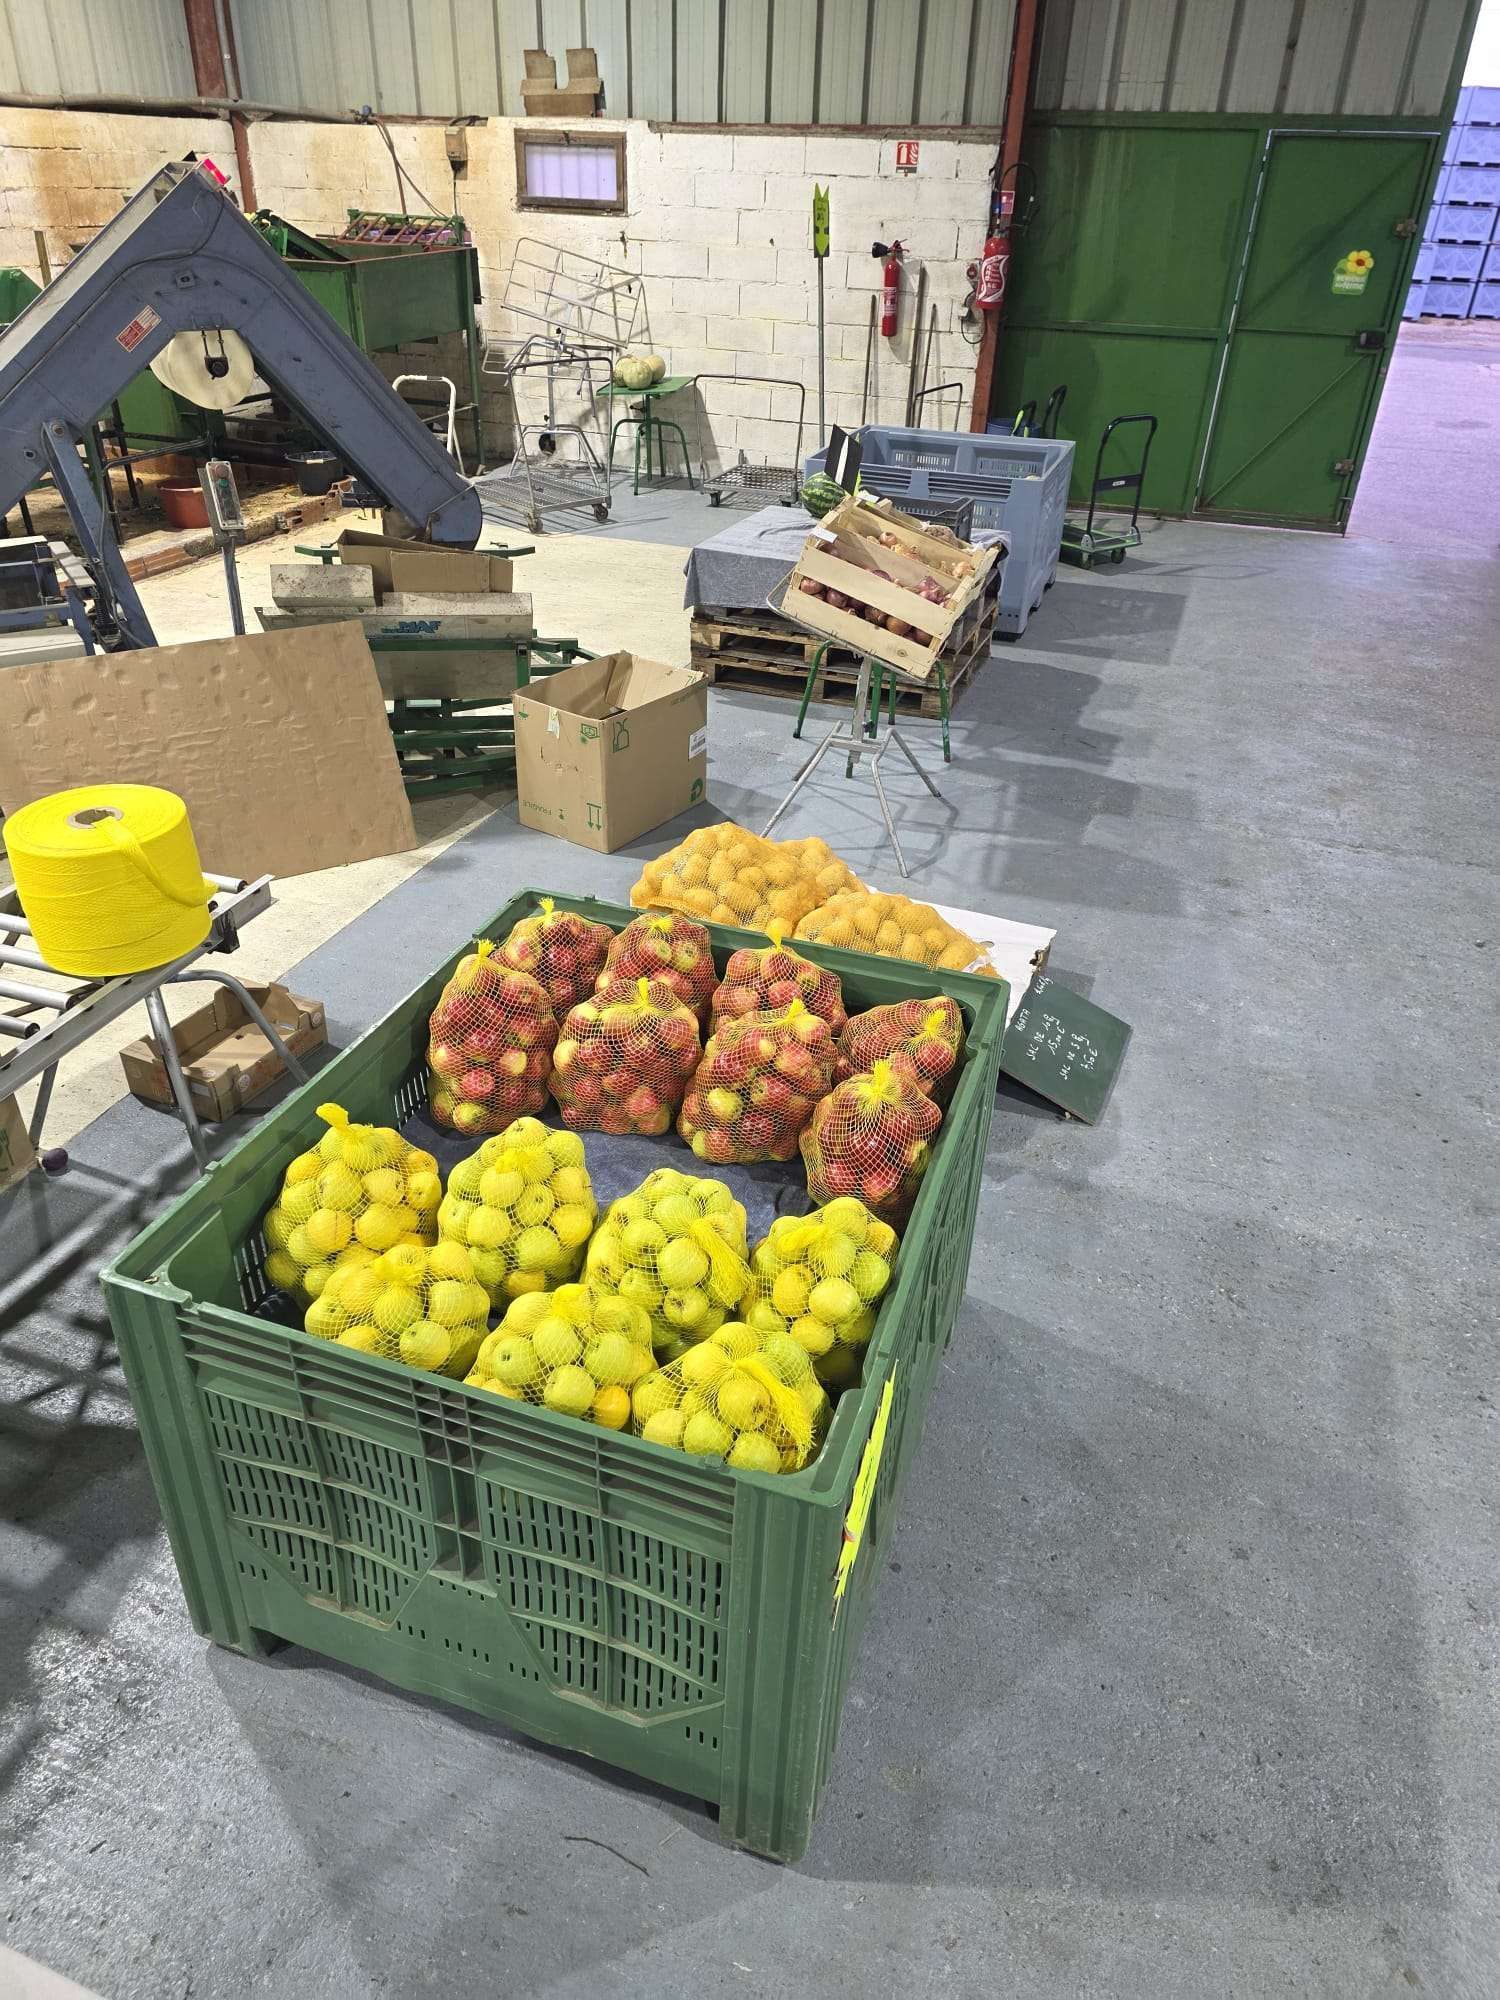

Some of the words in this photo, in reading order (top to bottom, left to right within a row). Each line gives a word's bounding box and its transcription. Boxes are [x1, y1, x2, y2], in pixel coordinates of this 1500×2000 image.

[1014, 1008, 1031, 1032] AGATA
[1025, 1043, 1039, 1061] SAC
[1033, 1031, 1045, 1043] DE
[1059, 1064, 1071, 1080] SAC
